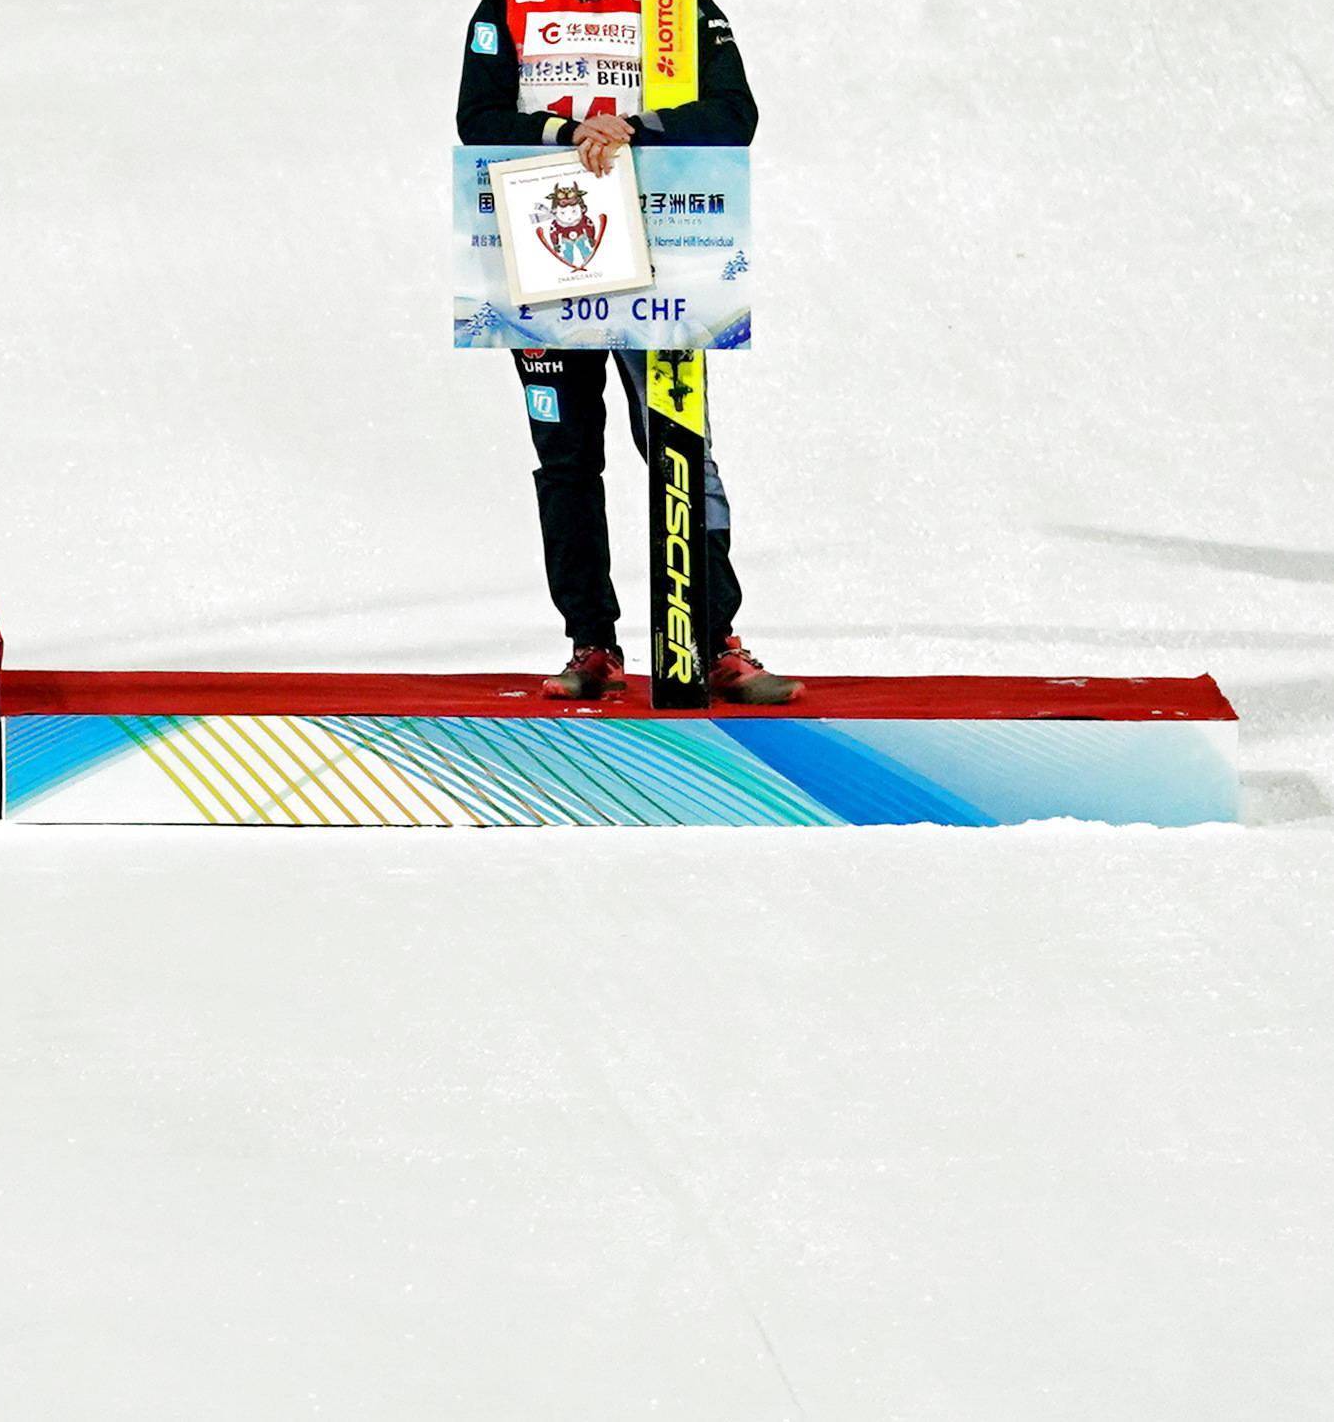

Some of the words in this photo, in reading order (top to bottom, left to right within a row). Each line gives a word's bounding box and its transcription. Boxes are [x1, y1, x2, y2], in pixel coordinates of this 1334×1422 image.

[566, 23, 636, 39] 华夏银行
[655, 235, 682, 247] Normal
[561, 298, 610, 321] 300
[631, 298, 687, 321] CHF
[665, 446, 693, 685] FISCHER
